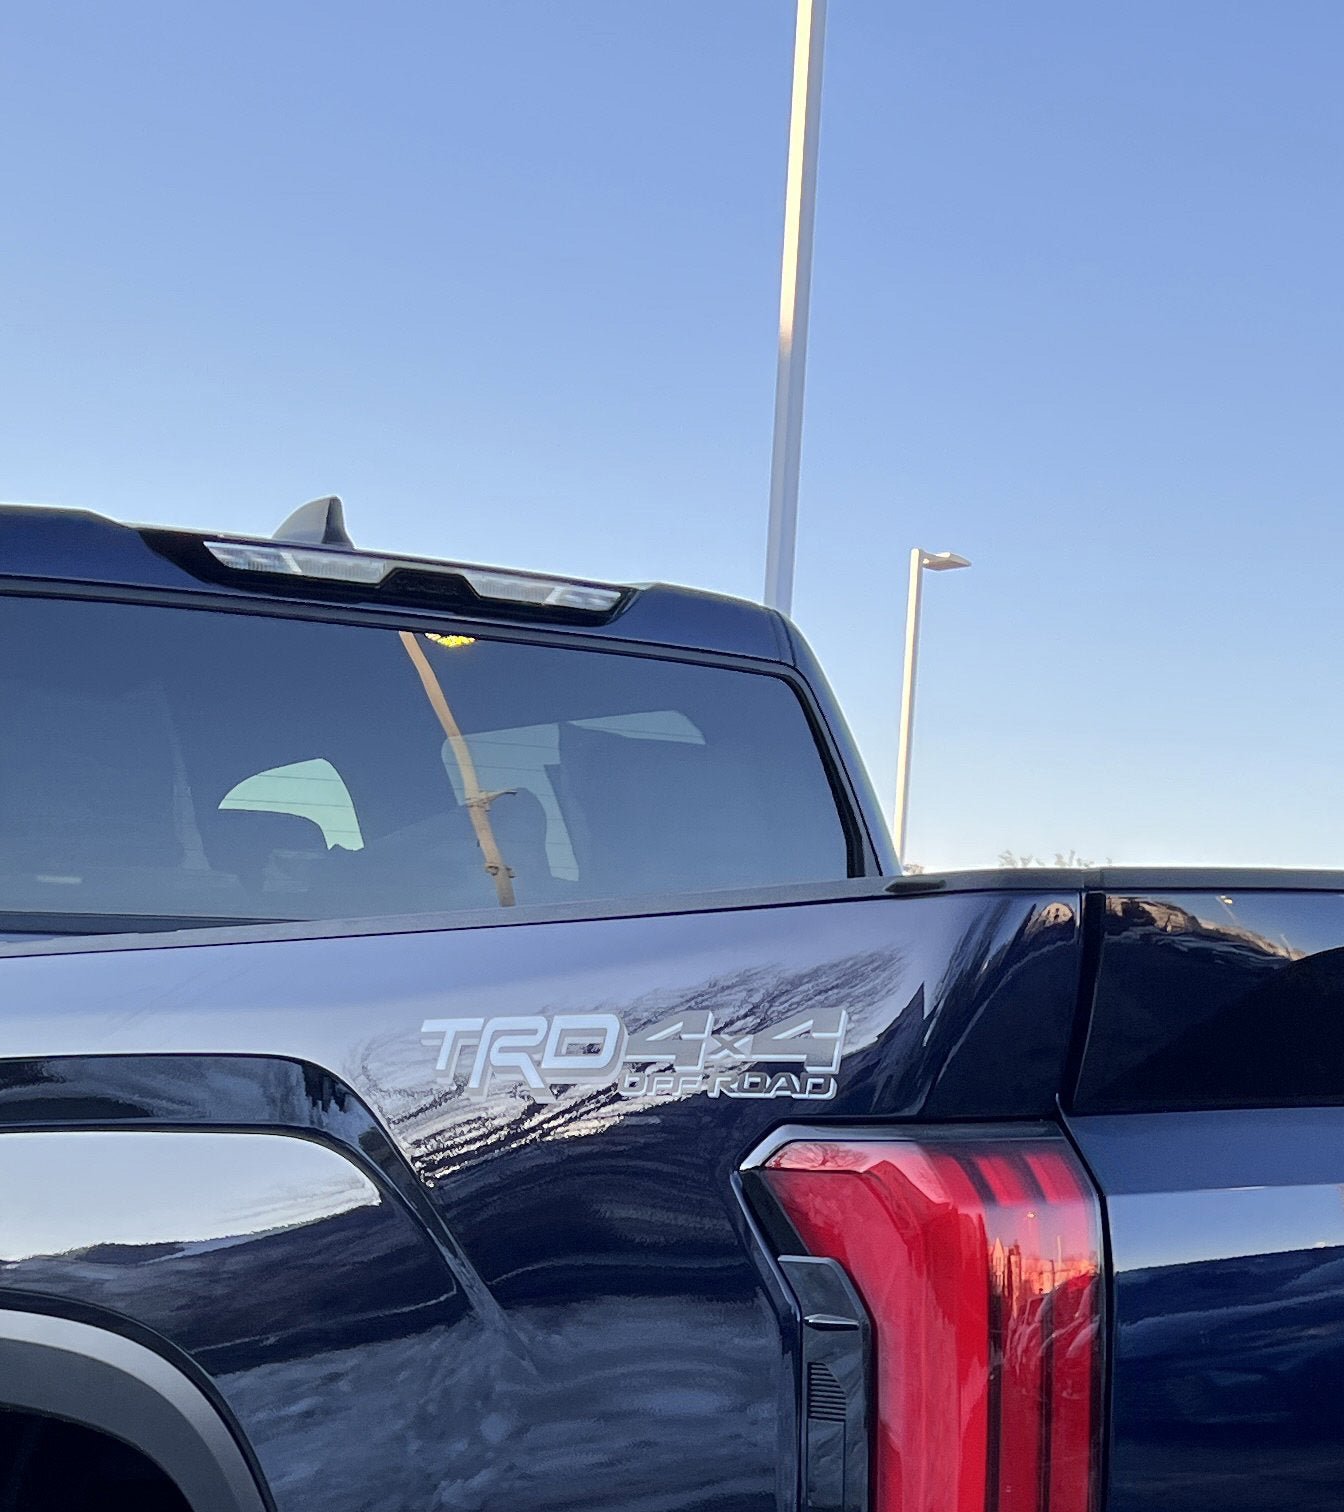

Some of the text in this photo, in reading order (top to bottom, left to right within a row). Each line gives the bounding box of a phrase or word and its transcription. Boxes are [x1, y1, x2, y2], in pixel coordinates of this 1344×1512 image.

[420, 1013, 628, 1104] TRD
[618, 1070, 838, 1101] OFF ROAD
